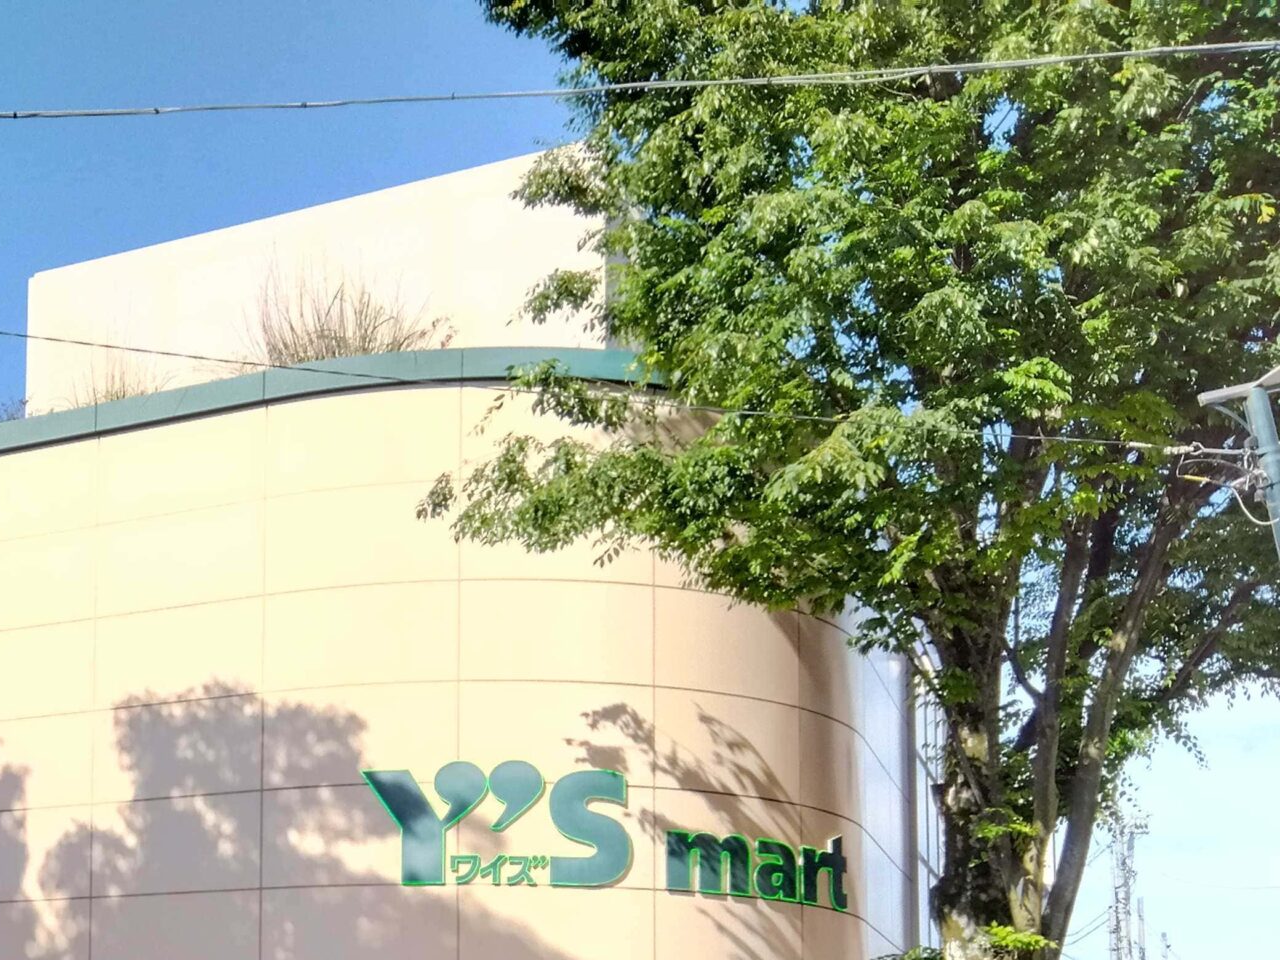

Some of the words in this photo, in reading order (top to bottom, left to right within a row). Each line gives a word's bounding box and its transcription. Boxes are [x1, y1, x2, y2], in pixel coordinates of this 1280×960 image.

[450, 854, 549, 887] ワイズ
[665, 828, 849, 912] mart
